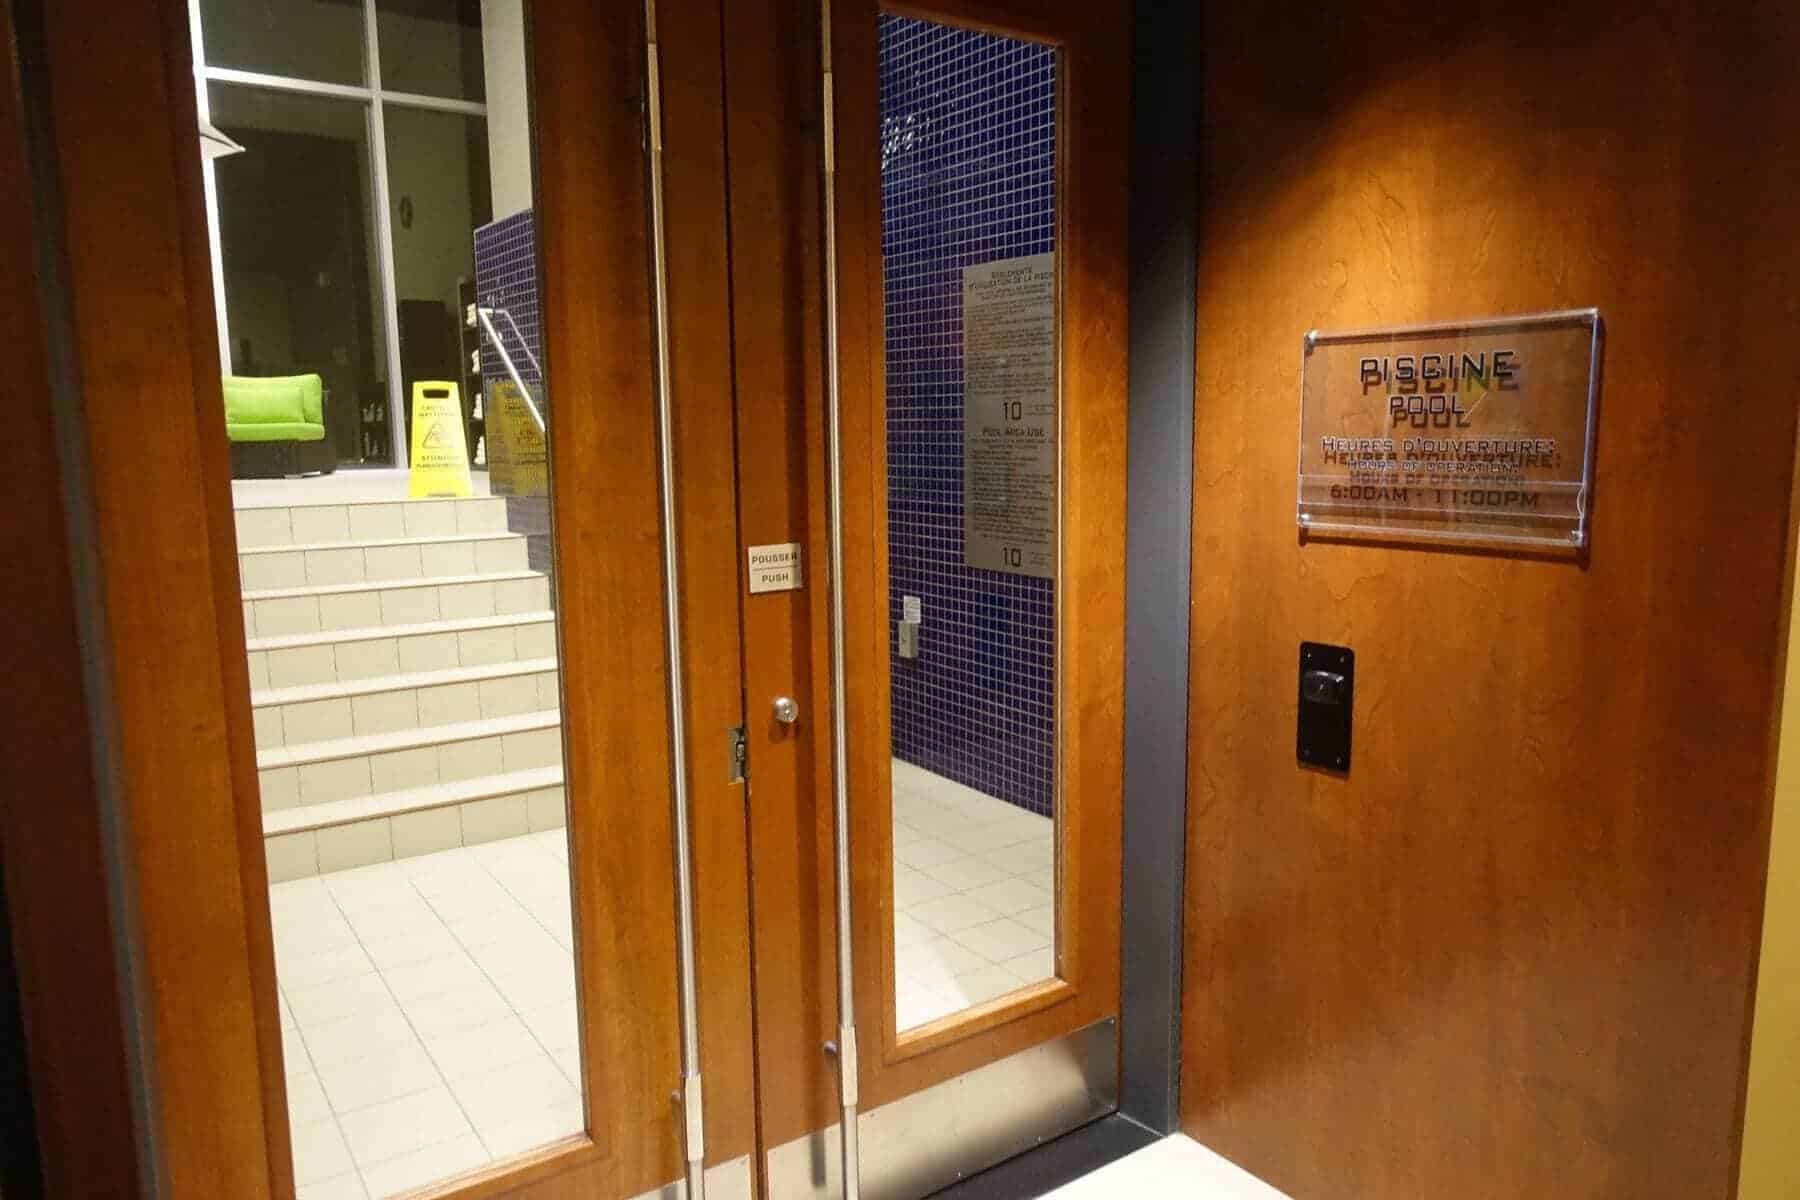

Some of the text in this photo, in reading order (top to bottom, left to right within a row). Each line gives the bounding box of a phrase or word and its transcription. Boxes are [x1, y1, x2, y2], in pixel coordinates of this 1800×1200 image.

[1361, 351, 1514, 383] PISCINE
[1003, 401, 1022, 420] 10
[1389, 396, 1465, 415] POOL
[1330, 484, 1408, 502] 6:00AM
[1435, 486, 1538, 507] 11:00PM
[1003, 546, 1022, 567] 10
[762, 572, 789, 583] PUSH
